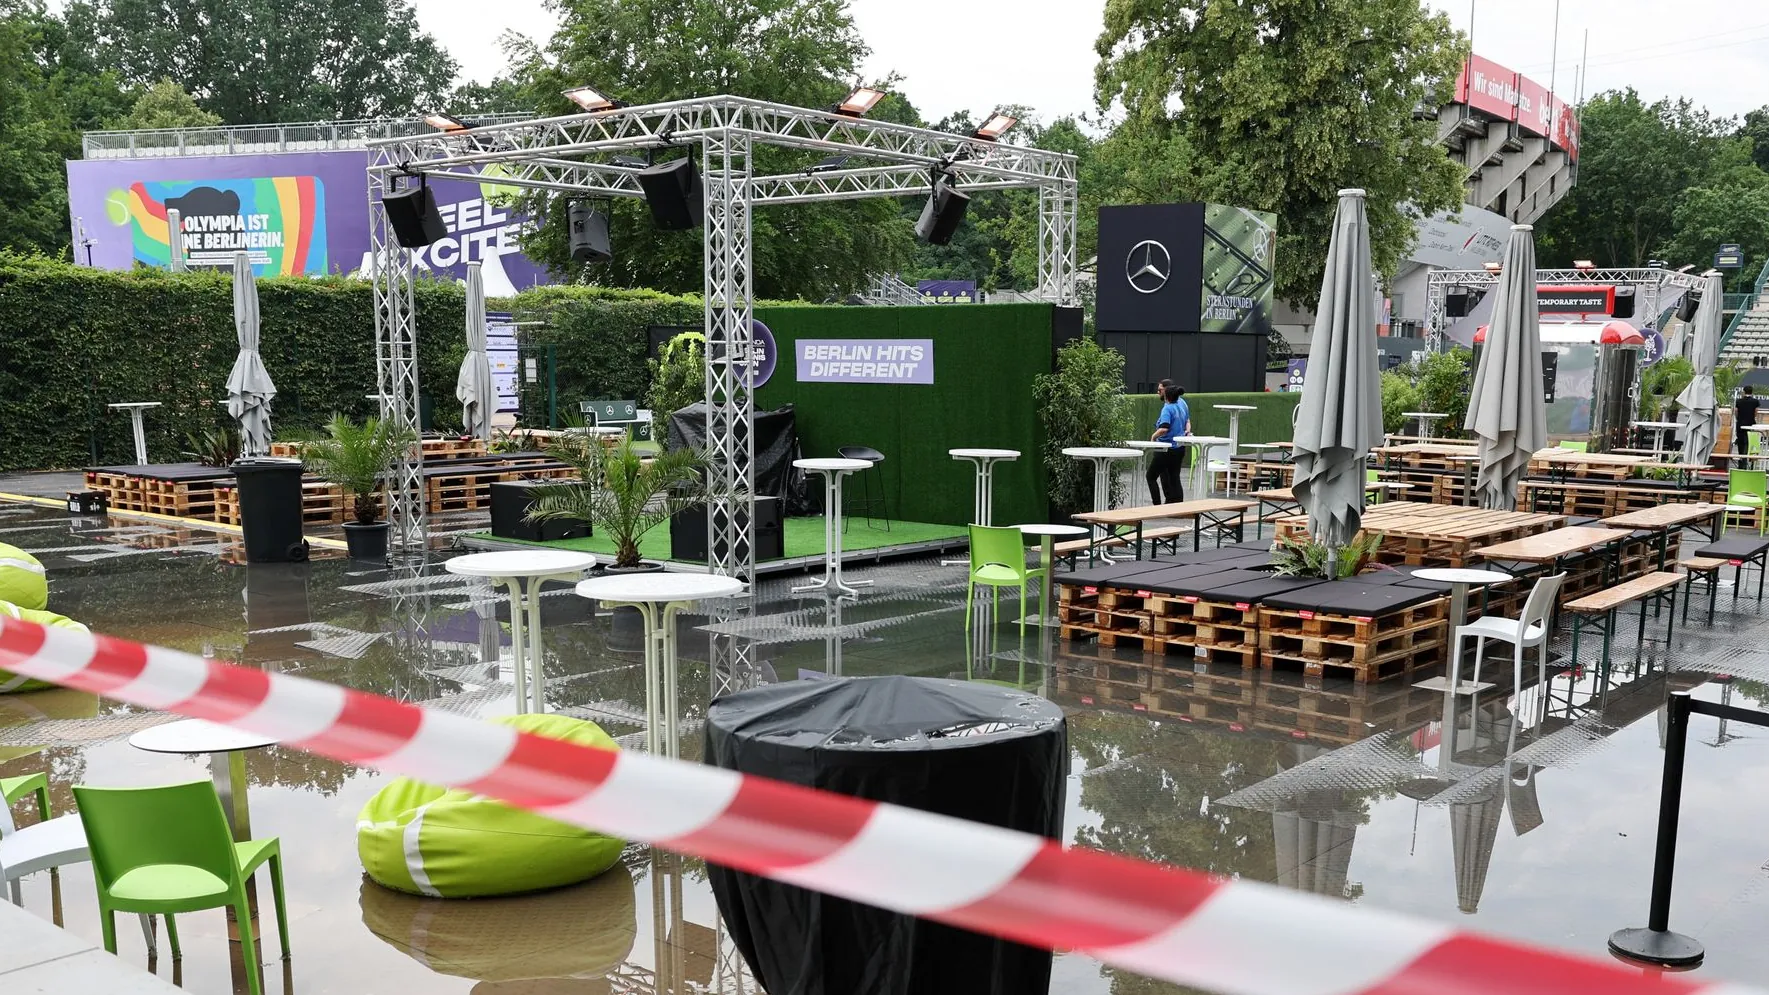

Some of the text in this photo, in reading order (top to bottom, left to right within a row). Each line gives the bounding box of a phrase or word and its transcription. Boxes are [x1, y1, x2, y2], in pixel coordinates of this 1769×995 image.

[1474, 70, 1487, 94] Wir
[1488, 77, 1504, 101] sind
[184, 214, 269, 232] OLYMPIA IST
[180, 232, 285, 249] INE BERLINERIN.
[1206, 295, 1253, 308] STERNSTUNDEN
[1206, 307, 1237, 320] IN BERLIN
[804, 346, 924, 361] BERLIN HITS
[811, 362, 918, 378] DIFFERENT
